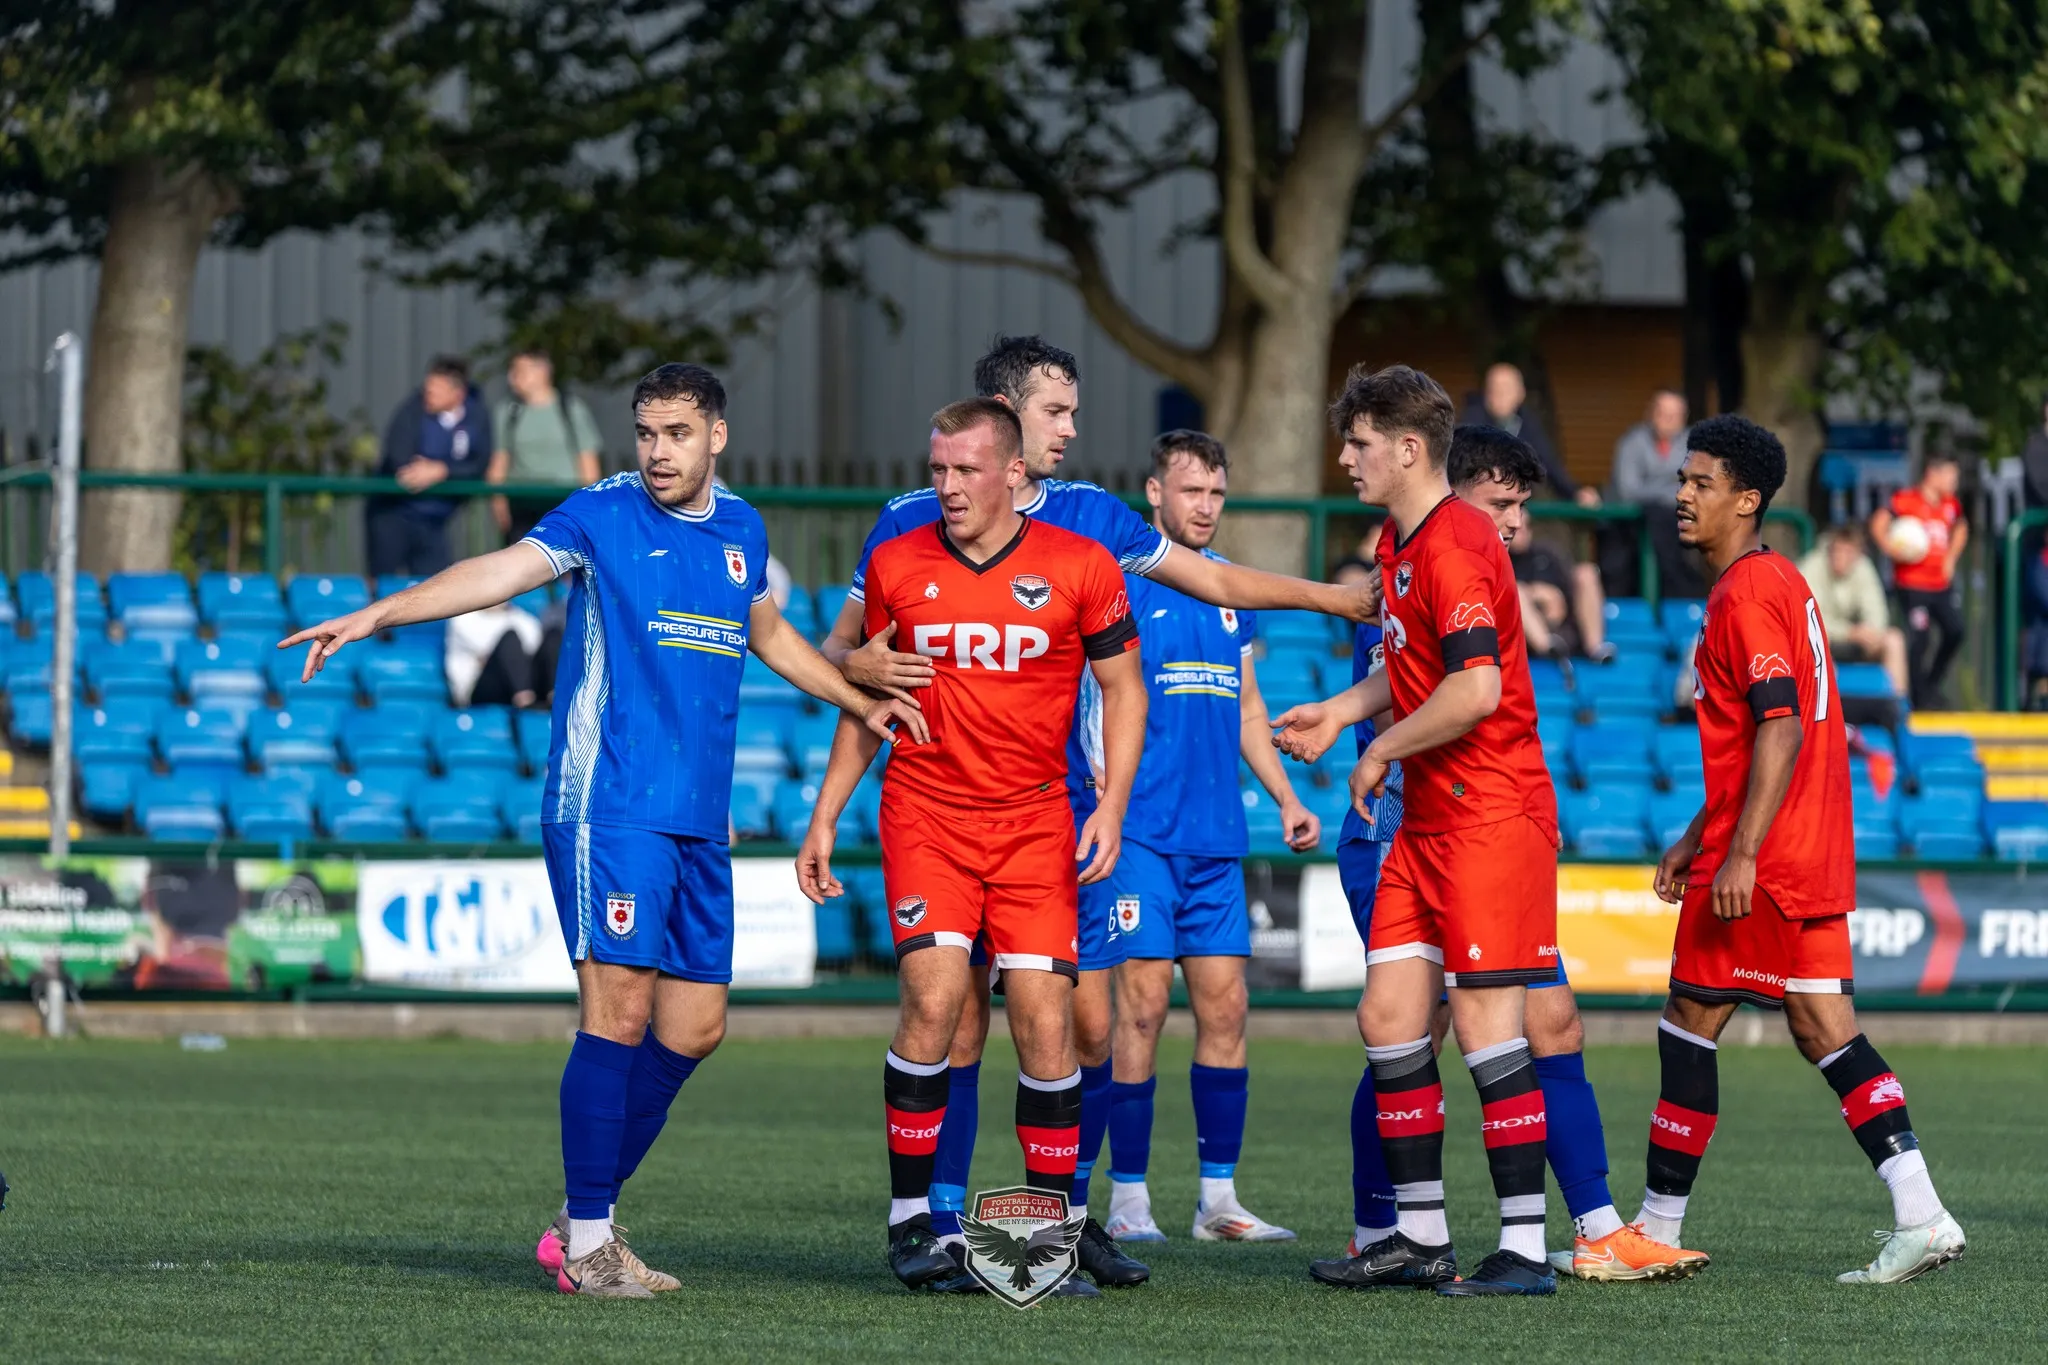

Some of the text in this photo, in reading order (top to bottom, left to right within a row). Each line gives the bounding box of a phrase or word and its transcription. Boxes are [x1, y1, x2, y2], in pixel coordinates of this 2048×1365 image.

[647, 620, 747, 647] PRESSURE TECH
[913, 622, 1050, 672] FRP
[607, 891, 636, 899] GLOSSOP
[1108, 906, 1116, 932] 6
[1732, 967, 1786, 988] MotaWo
[1376, 1108, 1424, 1121] OM
[1651, 1112, 1692, 1137] IOM
